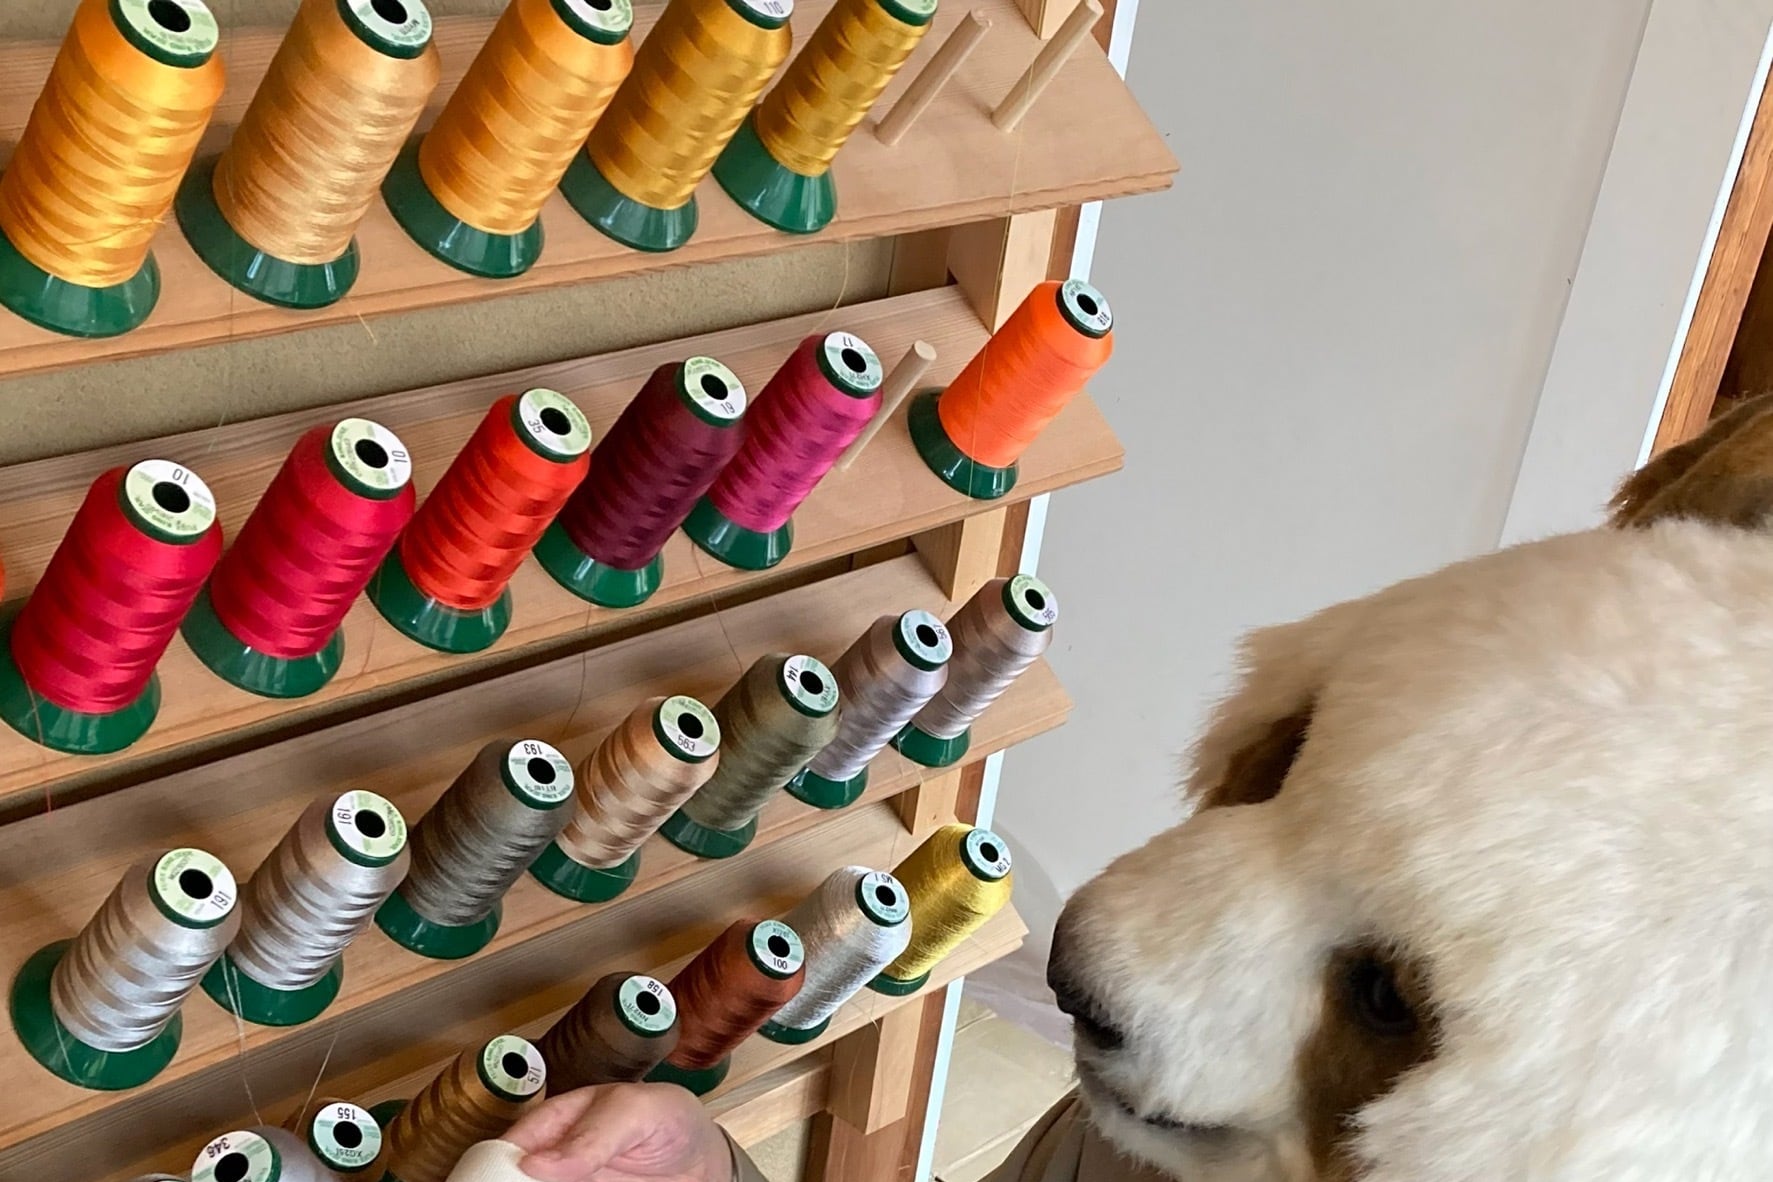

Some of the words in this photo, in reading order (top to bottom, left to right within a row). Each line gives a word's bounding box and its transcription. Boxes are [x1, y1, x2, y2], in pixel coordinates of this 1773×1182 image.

[721, 402, 736, 415] 19
[528, 419, 545, 435] 35
[392, 450, 407, 463] 10
[172, 468, 190, 485] 10
[786, 666, 798, 683] 144
[524, 743, 542, 756] 193
[677, 735, 696, 752] 563
[336, 807, 352, 826] 191
[211, 891, 231, 910] 191
[772, 957, 788, 970] 100
[647, 980, 664, 996] 158
[528, 1066, 543, 1084] 571
[337, 1107, 357, 1121] 155
